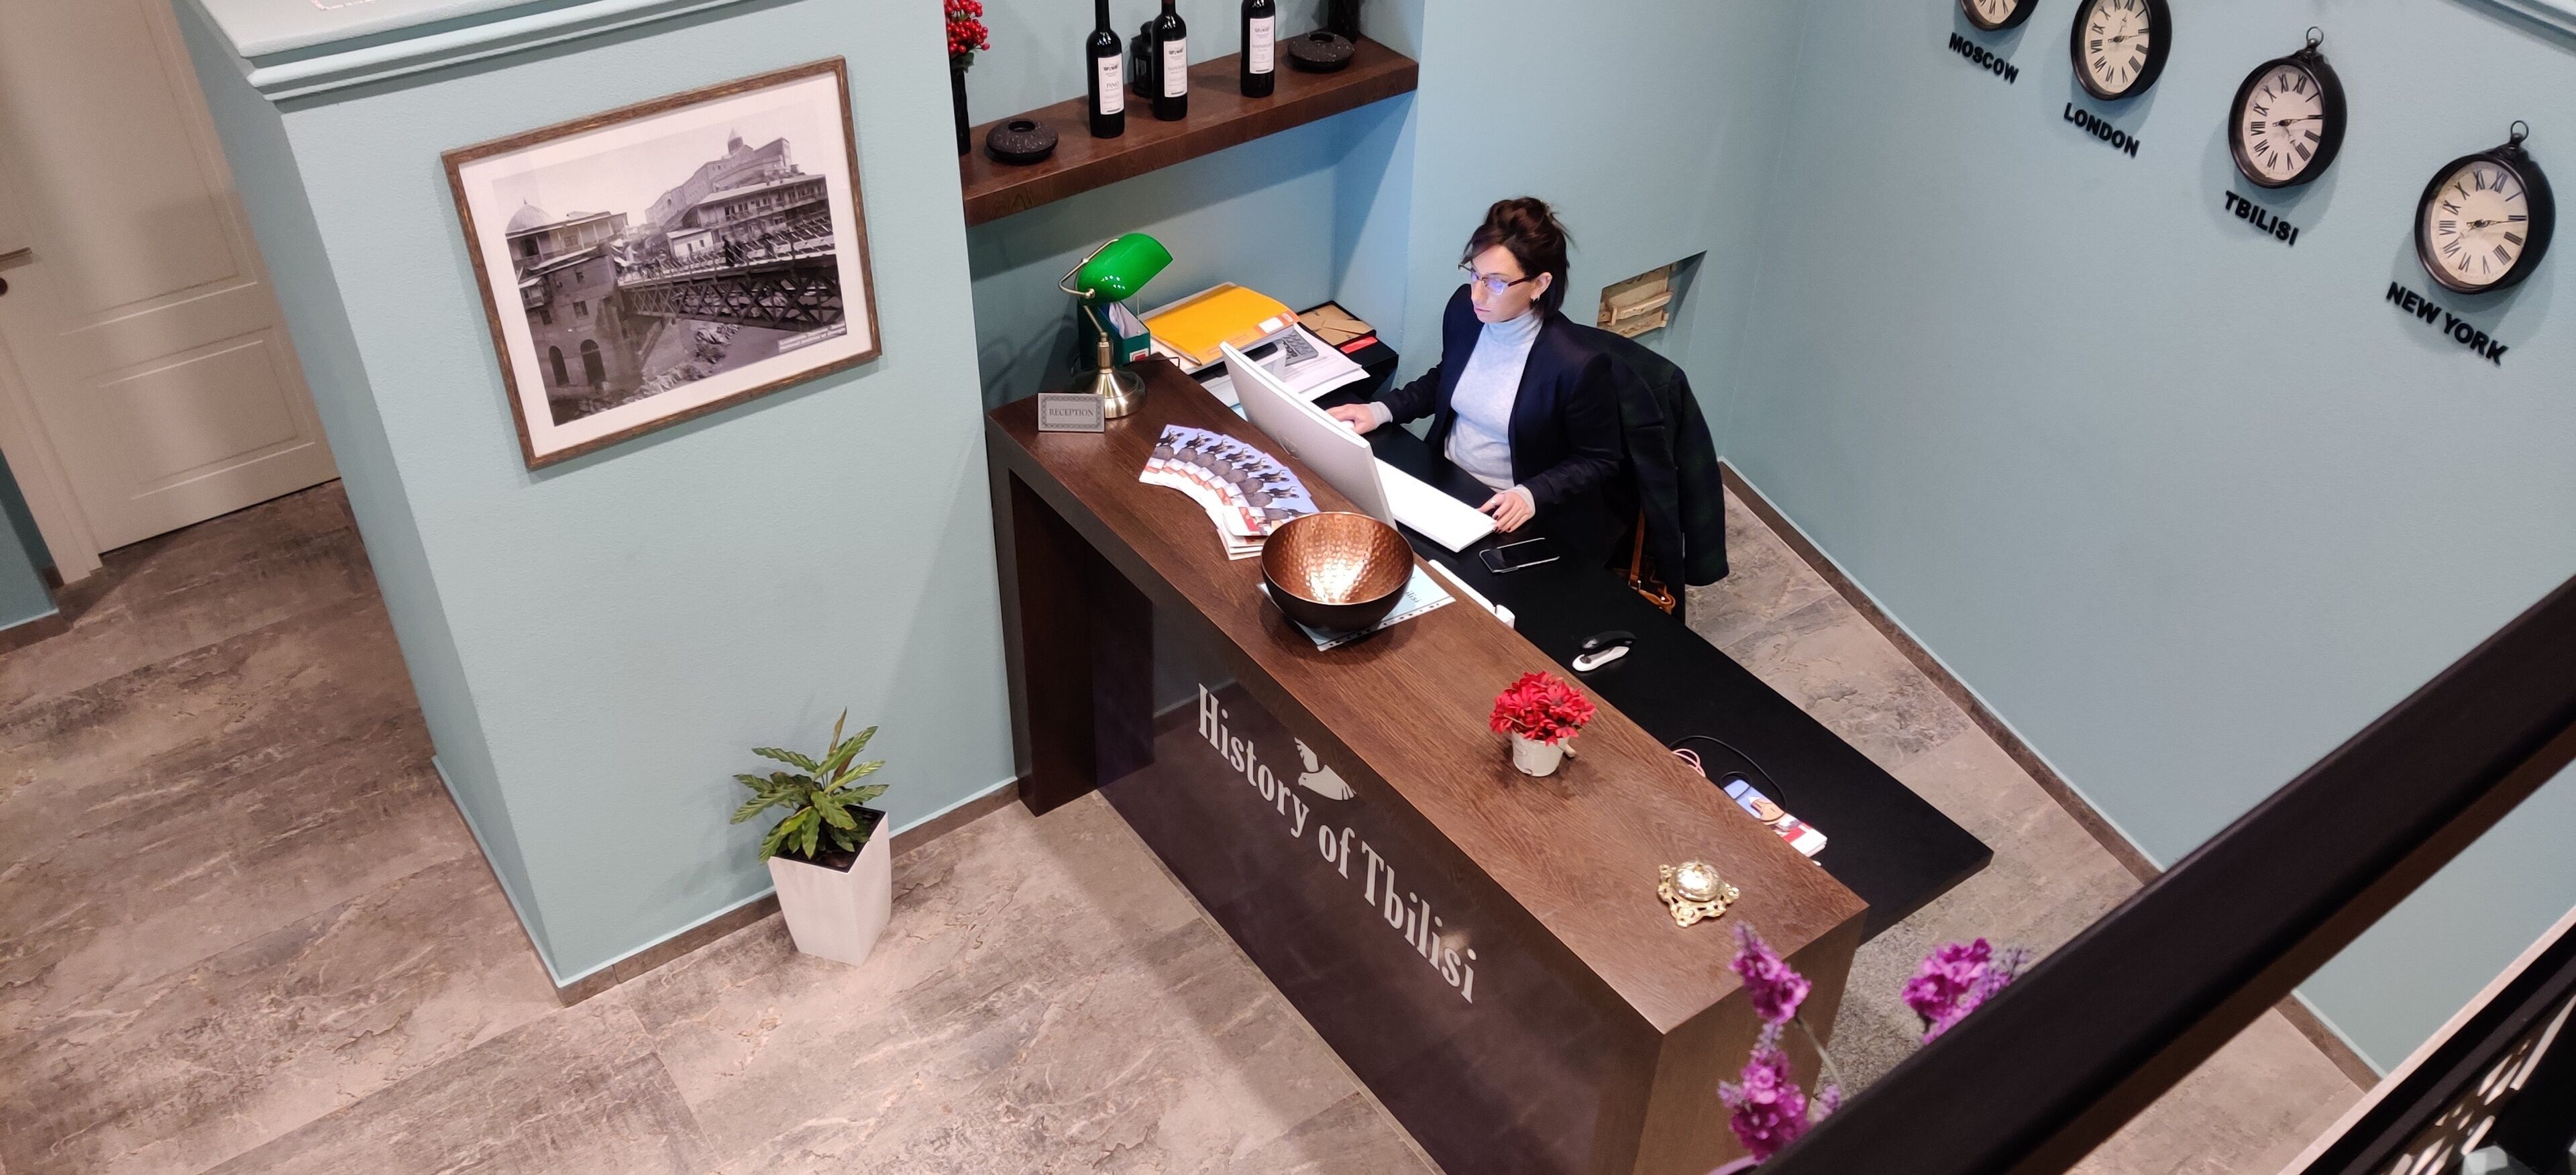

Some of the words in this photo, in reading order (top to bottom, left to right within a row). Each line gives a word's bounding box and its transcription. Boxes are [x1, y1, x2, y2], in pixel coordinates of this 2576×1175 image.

[1949, 32, 2019, 85] MOSCOW
[2063, 102, 2140, 158] LONDON
[2225, 191, 2300, 246] TBILISI
[2386, 282, 2442, 325] NEW
[2444, 313, 2509, 366] YORK
[1049, 408, 1093, 416] RECEPTION
[1199, 682, 1309, 838] History
[1319, 825, 1355, 879] of
[1362, 840, 1476, 1004] Tbilisi
